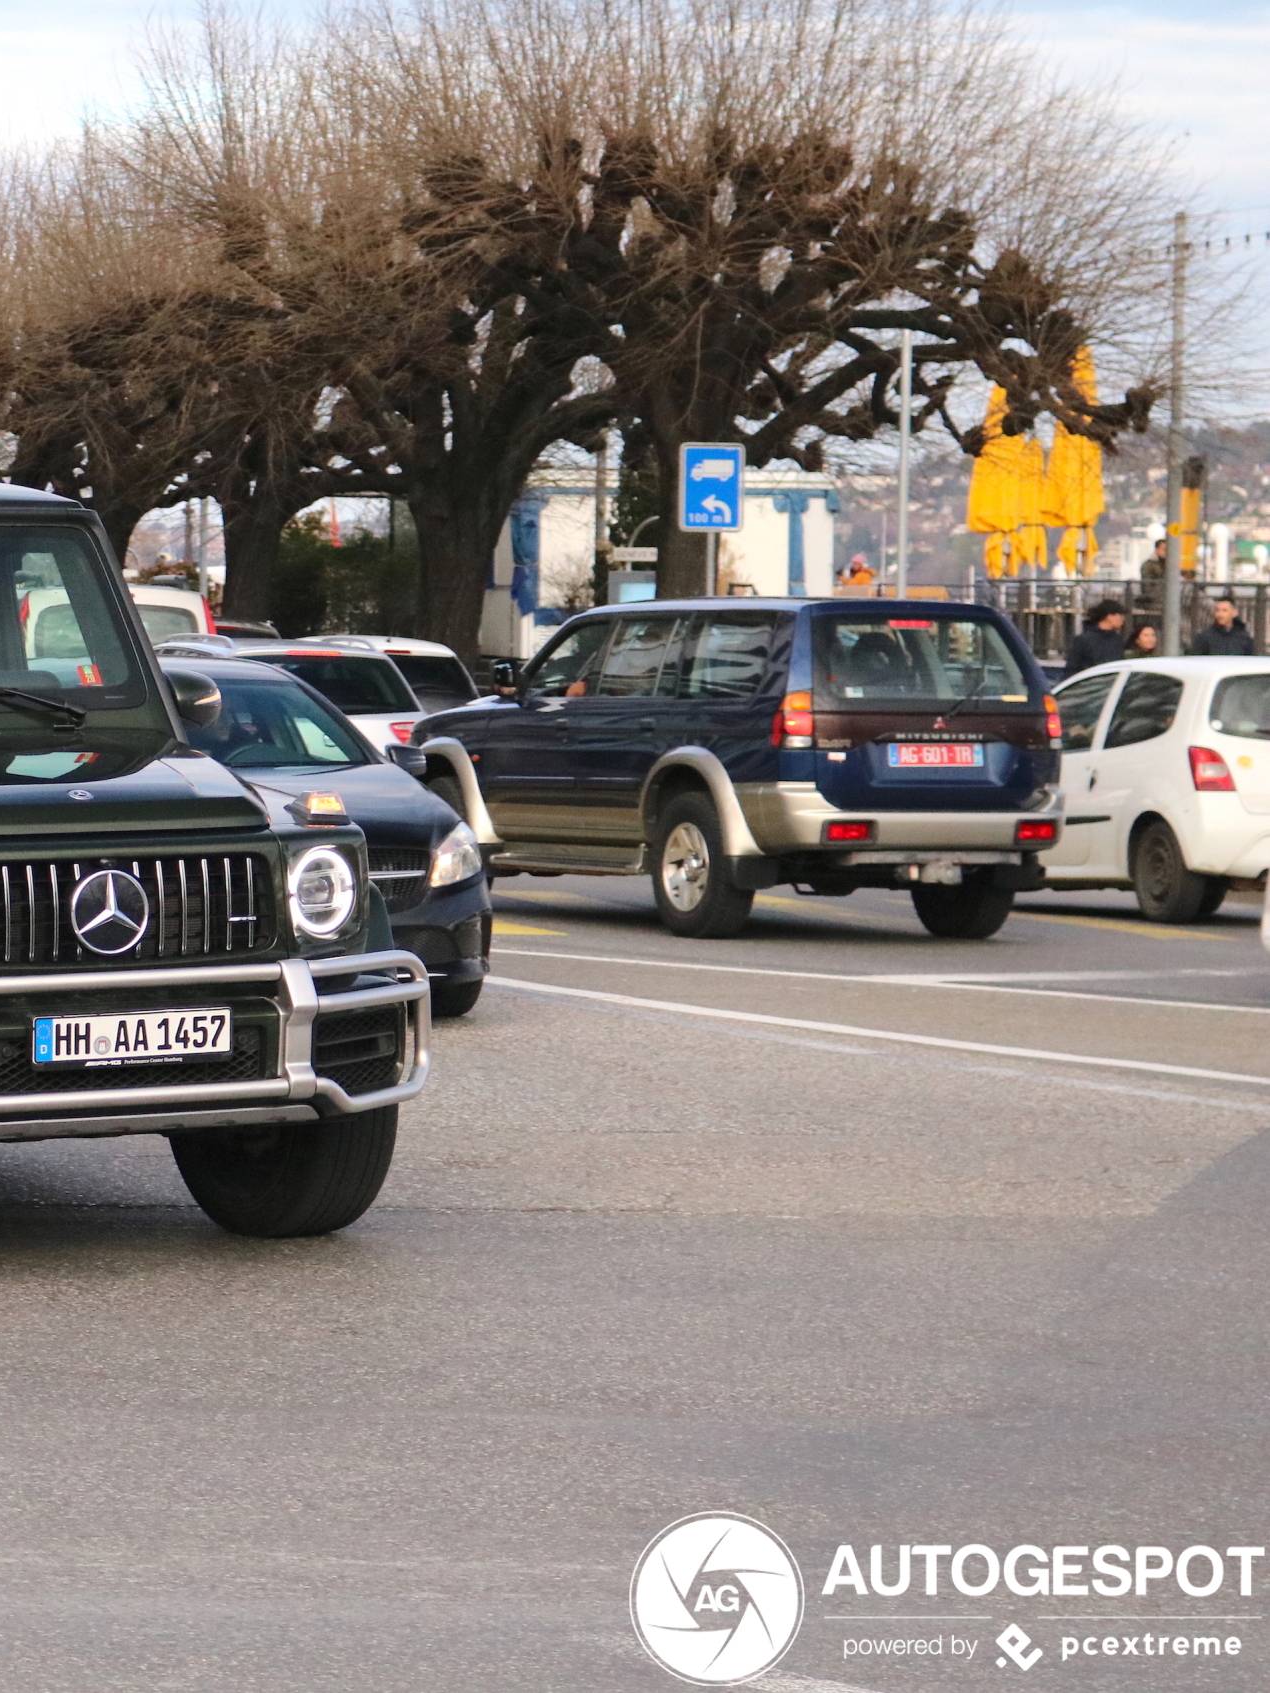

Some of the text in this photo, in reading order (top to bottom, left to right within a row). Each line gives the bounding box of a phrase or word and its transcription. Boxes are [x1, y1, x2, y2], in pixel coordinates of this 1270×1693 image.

[688, 512, 723, 523] 100 m
[895, 732, 984, 741] MITSUBISHI
[55, 1014, 226, 1056] HH AA 1457
[40, 1044, 48, 1055] D
